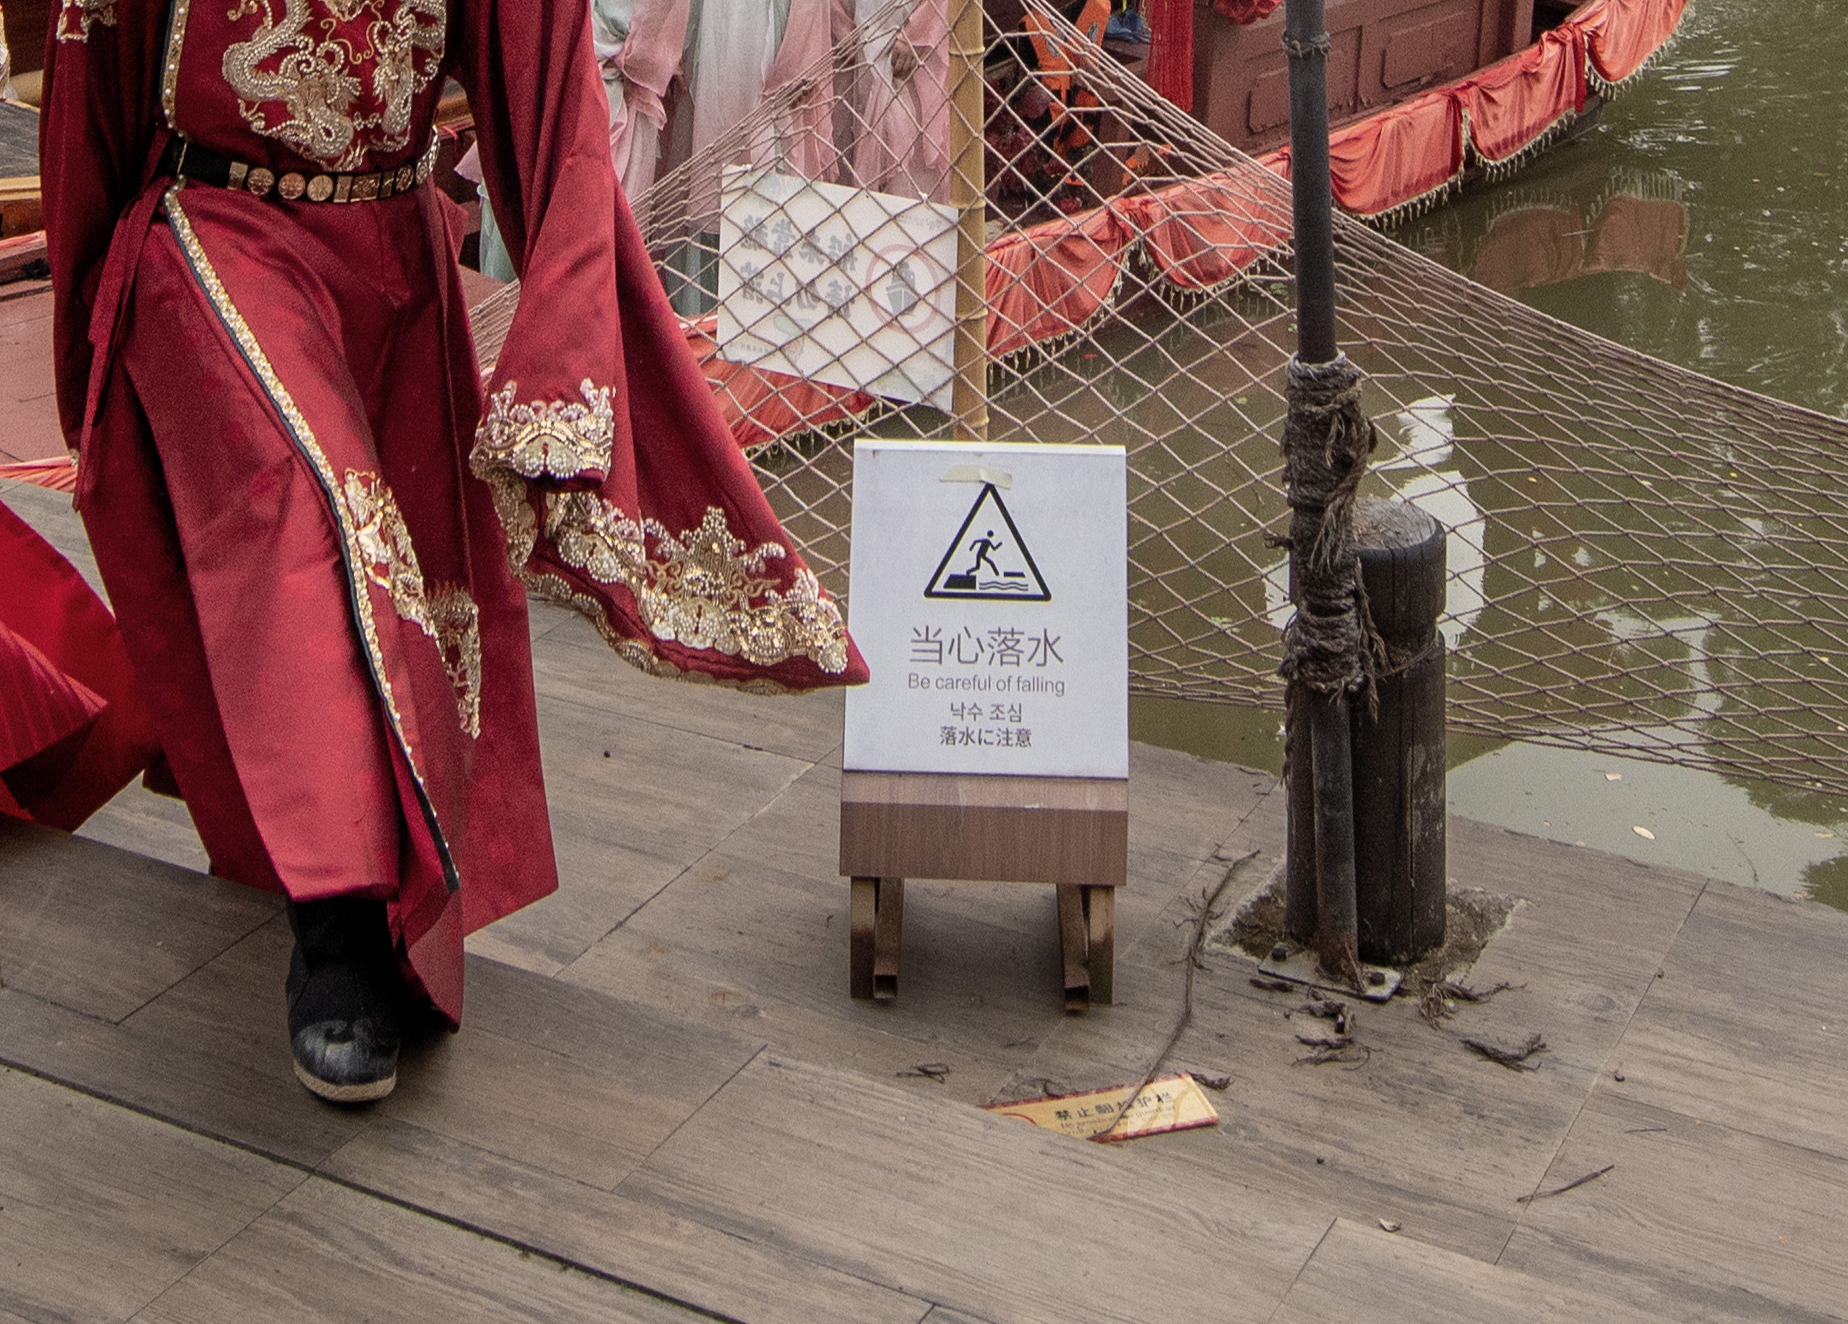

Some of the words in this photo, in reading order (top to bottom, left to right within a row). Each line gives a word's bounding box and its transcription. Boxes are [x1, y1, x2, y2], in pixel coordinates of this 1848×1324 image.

[909, 625, 1064, 667] 当心落水
[908, 673, 930, 689] Be
[935, 674, 991, 691] careful
[996, 675, 1013, 692] of
[1017, 676, 1065, 697] falling
[950, 701, 983, 722] 낙수
[989, 703, 1022, 723] 조심
[940, 725, 1032, 748] 落水に注意
